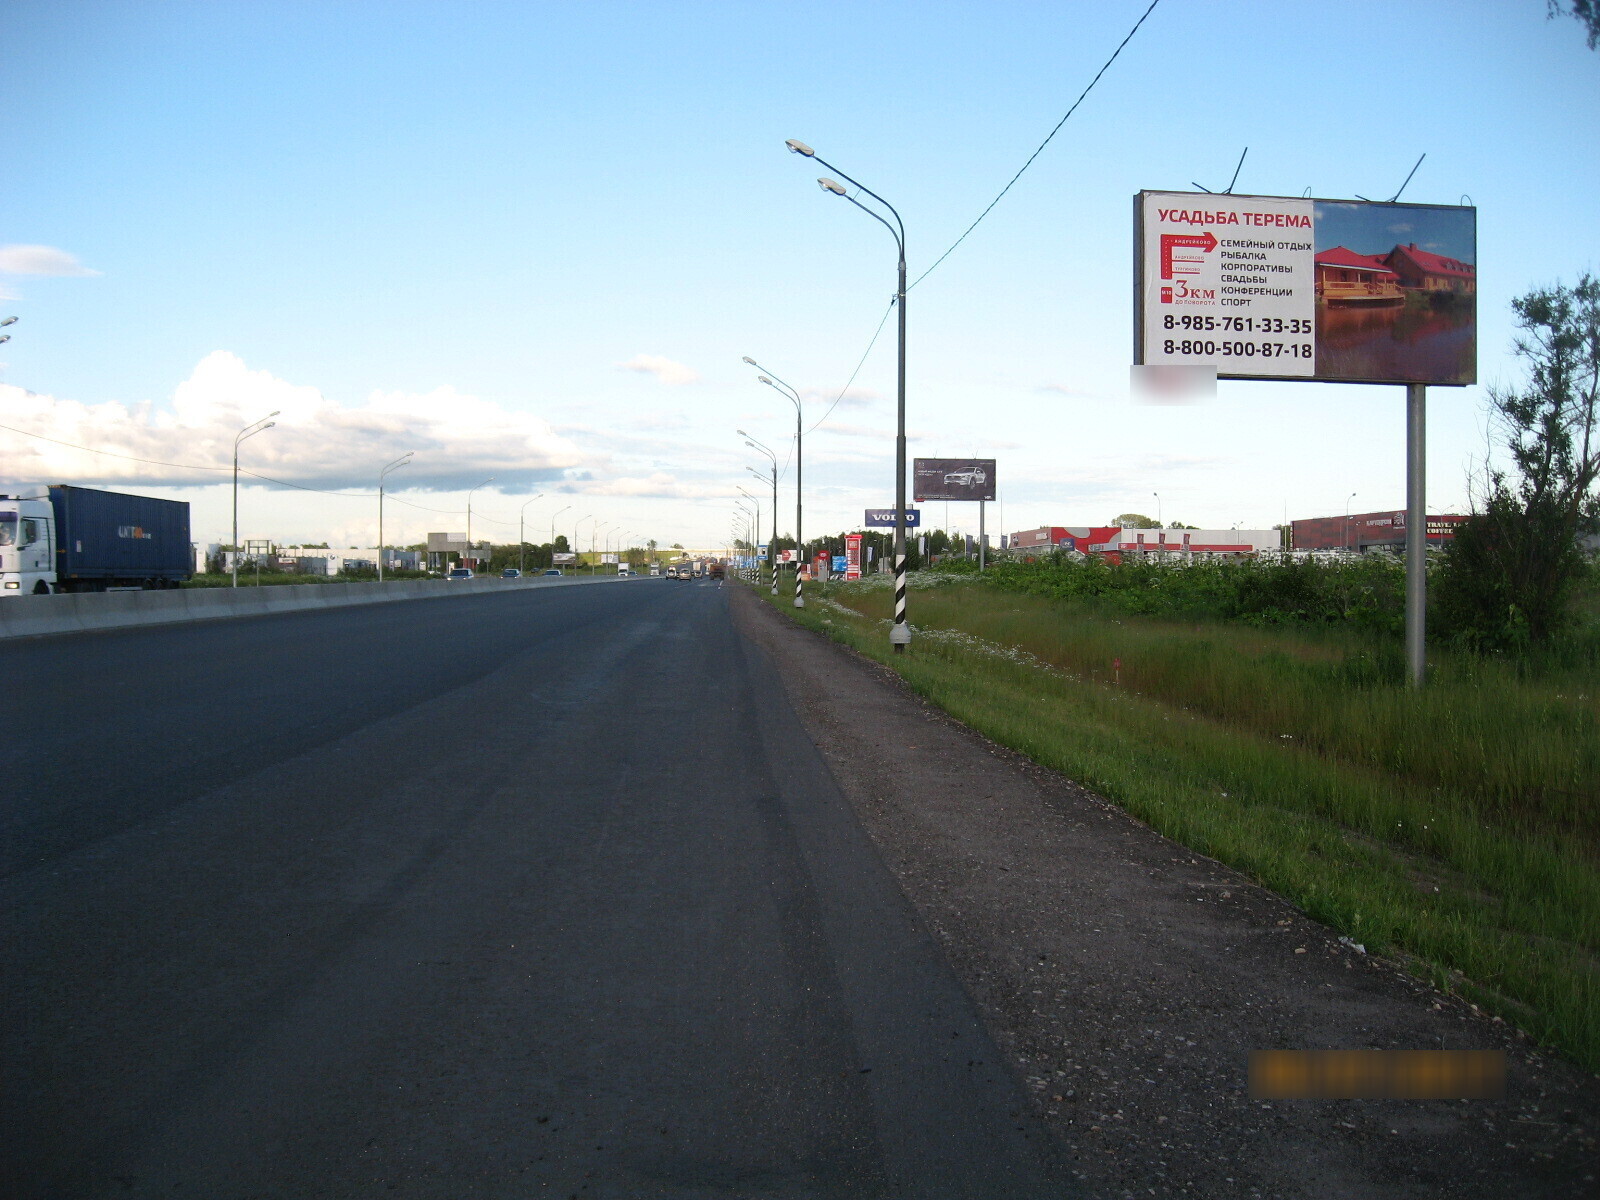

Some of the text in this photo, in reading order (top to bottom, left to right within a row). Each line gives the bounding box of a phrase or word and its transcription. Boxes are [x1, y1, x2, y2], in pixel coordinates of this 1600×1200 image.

[1157, 208, 1312, 228] УСАДЬБА ТЕРЕМА
[1220, 238, 1312, 251] СЕМЕЙНЫЙ ОТДЫХ
[1220, 251, 1267, 261] РЫБАЛКА
[1221, 263, 1293, 274] КОРПОРАТИВЫ
[1220, 274, 1267, 285] СВАДЬБЫ
[1221, 286, 1293, 297] КОНФЕРЕНЦИИ
[1220, 298, 1252, 307] СПОРТ
[1163, 314, 1312, 334] 8-985-761-33-35
[1163, 339, 1312, 359] 8-800-500-87-18
